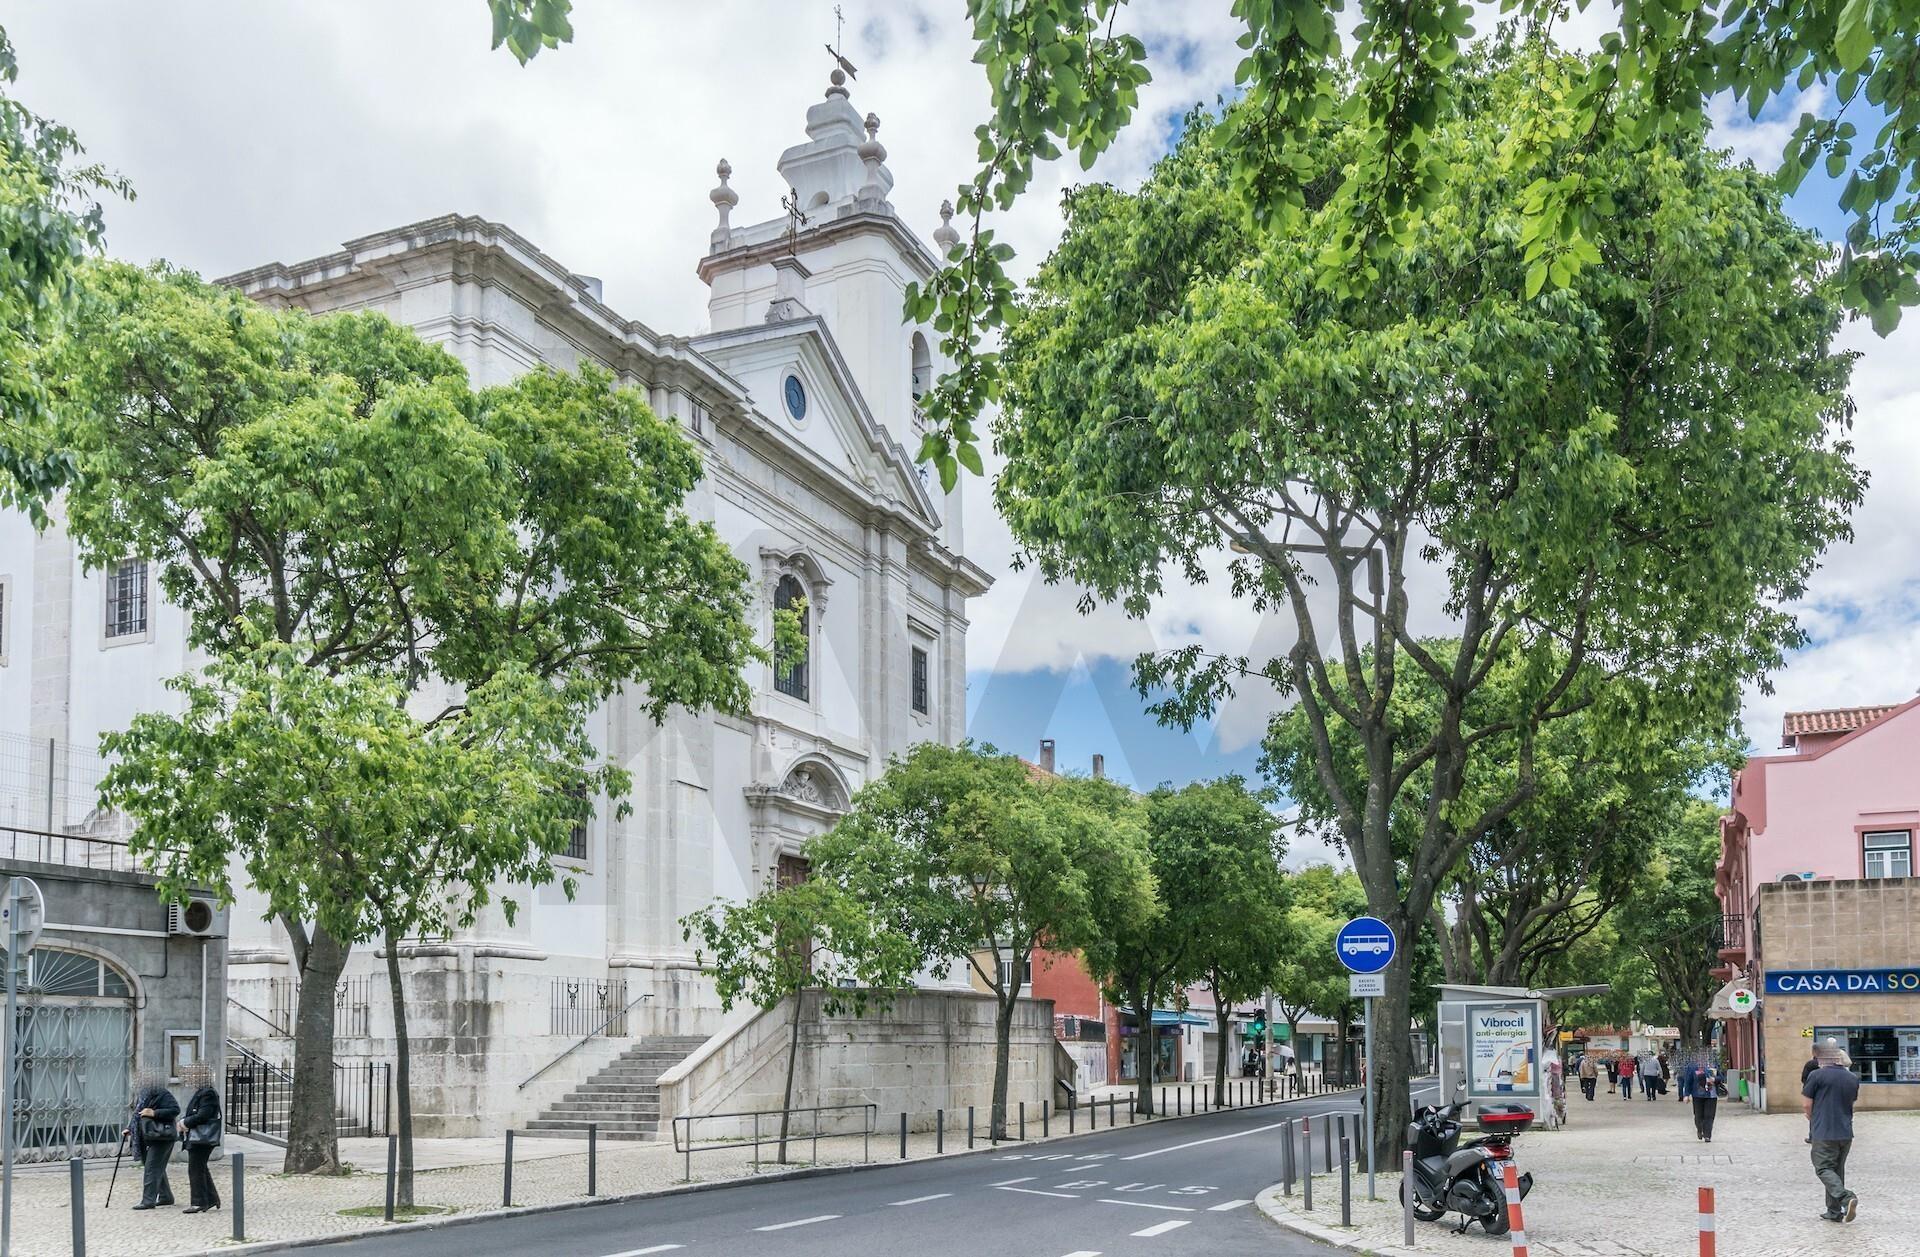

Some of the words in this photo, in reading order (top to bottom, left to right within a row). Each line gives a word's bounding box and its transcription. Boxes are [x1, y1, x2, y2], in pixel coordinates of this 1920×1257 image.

[1778, 975, 1840, 991] CASA
[1847, 974, 1880, 990] DA
[1887, 973, 1920, 990] SO
[1480, 1017, 1524, 1028] Vibrocil
[1475, 1029, 1527, 1038] anti-alergias
[1053, 1180, 1219, 1195] BUS
